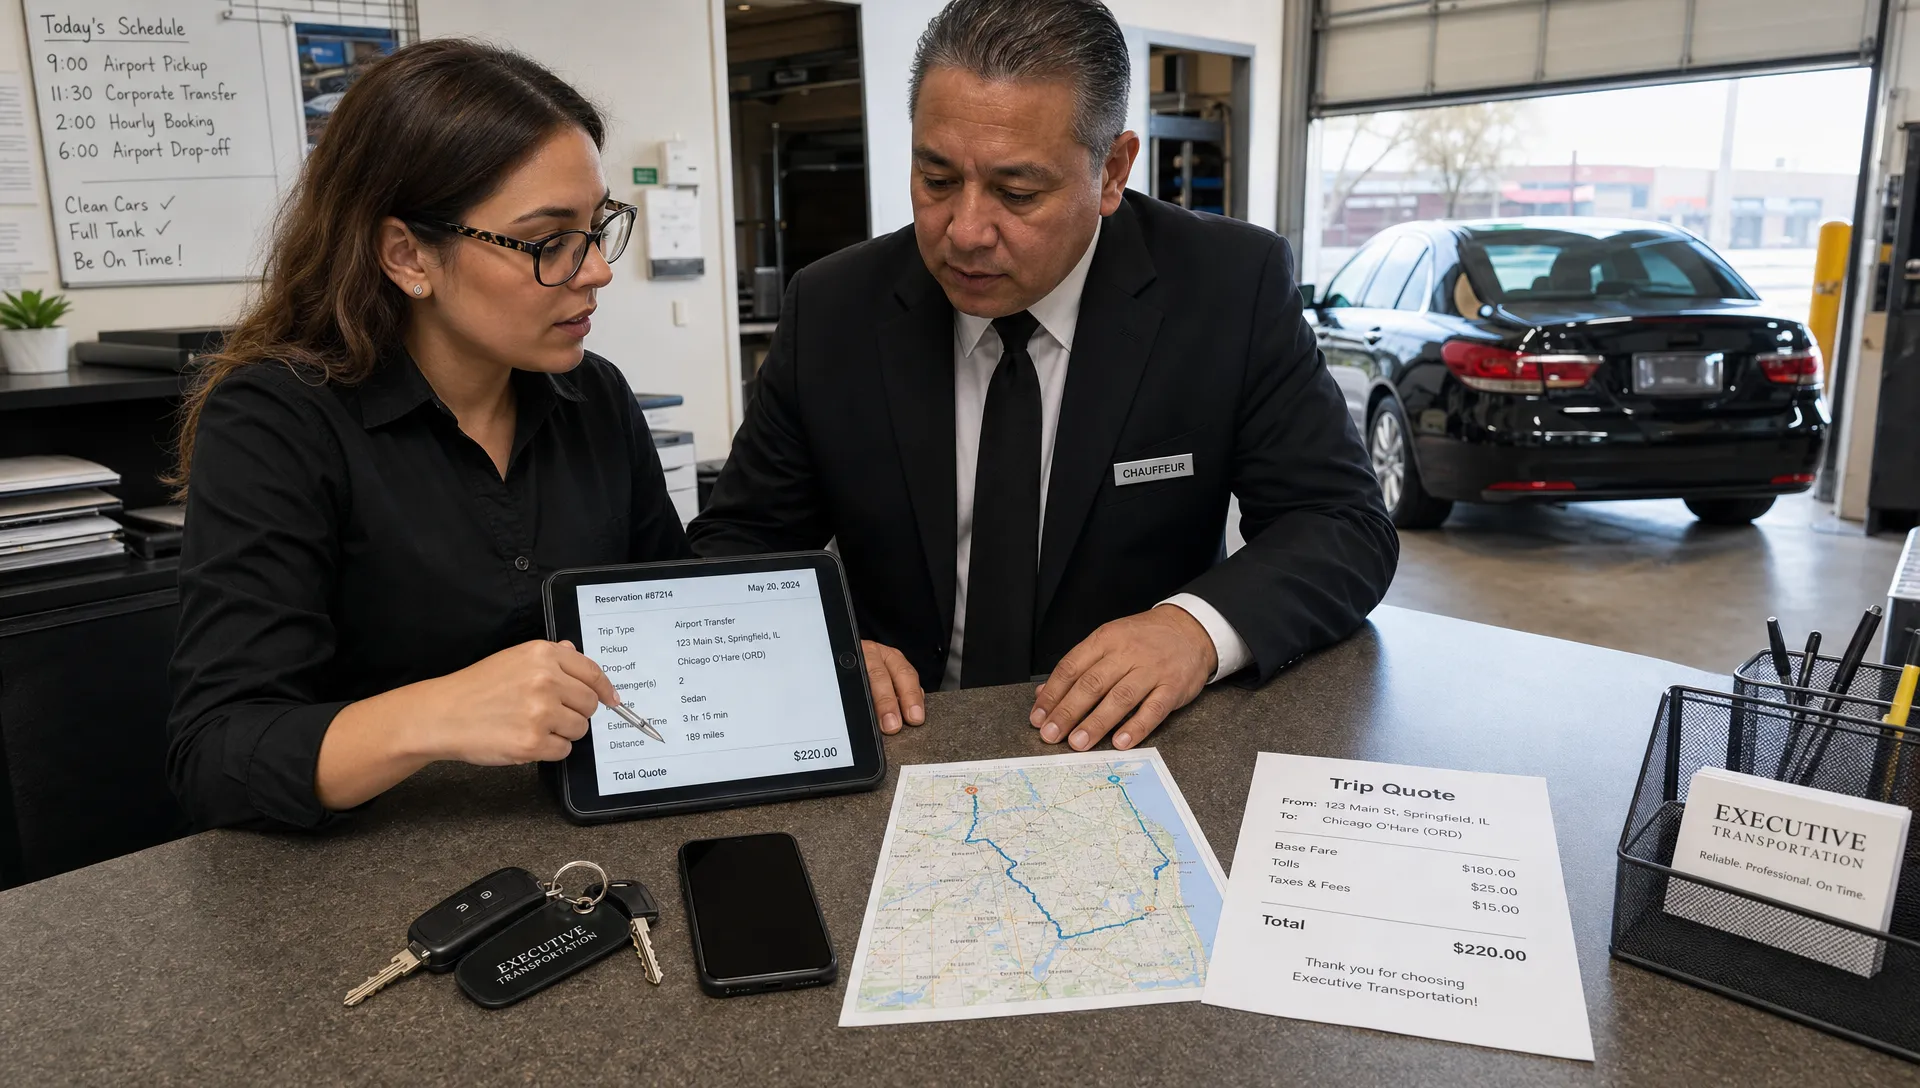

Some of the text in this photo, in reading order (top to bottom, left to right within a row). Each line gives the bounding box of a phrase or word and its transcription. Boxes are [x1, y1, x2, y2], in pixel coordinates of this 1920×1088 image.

[40, 14, 186, 43] Today's Schedule
[47, 53, 208, 79] 9:00 Airport Pickup
[51, 82, 237, 107] 11:30 Corporate Transfer
[56, 112, 215, 138] 2:00 Hourly Booking
[59, 137, 231, 164] 6:00 Airport Drop-off
[65, 195, 148, 214] Clean Cars
[69, 221, 145, 240] Full Tank
[73, 244, 182, 270] Be On Time!
[1123, 462, 1185, 478] CHAUFFEUR
[748, 581, 800, 593] May 20, 2024
[595, 590, 673, 603] Reservation #87214
[598, 626, 635, 636] Trip Type
[674, 617, 735, 629] Airport Transfer
[676, 638, 691, 647] 123
[714, 636, 726, 644] St,
[727, 632, 771, 644] Springfield,
[772, 631, 781, 639] IL
[600, 645, 628, 654] Pickup
[677, 651, 766, 666] Chicago O'Hare (ORD)
[602, 661, 636, 673] Drop-off
[613, 679, 656, 690] ssenger(s)
[679, 677, 684, 685] 2
[681, 695, 707, 703] Sedan
[608, 718, 667, 730] Estim Time
[682, 714, 689, 722] 3
[702, 712, 711, 720] 15
[713, 711, 728, 719] min
[686, 731, 725, 741] 189 miles
[610, 740, 645, 749] Distance
[794, 747, 837, 762] $220.00
[613, 768, 667, 781] Total Quote
[1330, 777, 1455, 801] Trip Quote
[1282, 797, 1317, 807] From:
[1325, 802, 1345, 810] 123
[1350, 804, 1379, 813] Main
[1383, 807, 1399, 816] St,
[1404, 810, 1474, 824] Springfield,
[1280, 812, 1462, 839] To: Chicago O'Hare (ORD)
[1713, 803, 1866, 854] EXECUTIVE
[1275, 842, 1338, 856] Base Fare
[1712, 825, 1864, 869] TRANSPORTATION
[1272, 858, 1299, 868] Tolls
[1462, 864, 1516, 878] $180.00
[1699, 850, 1865, 900] Reliable. Professional. On Time.
[1268, 875, 1350, 892] Taxes & Fees
[1471, 882, 1518, 896] $25.00
[1472, 900, 1519, 915] $15.00
[1262, 914, 1305, 930] Total
[497, 925, 587, 974] EXECUTIVE
[1453, 942, 1526, 961] $220.00
[496, 931, 597, 985] TRANSPORTATION
[1305, 957, 1464, 990] Thank you for choosing
[1293, 972, 1477, 1007] Executive Transportation!
